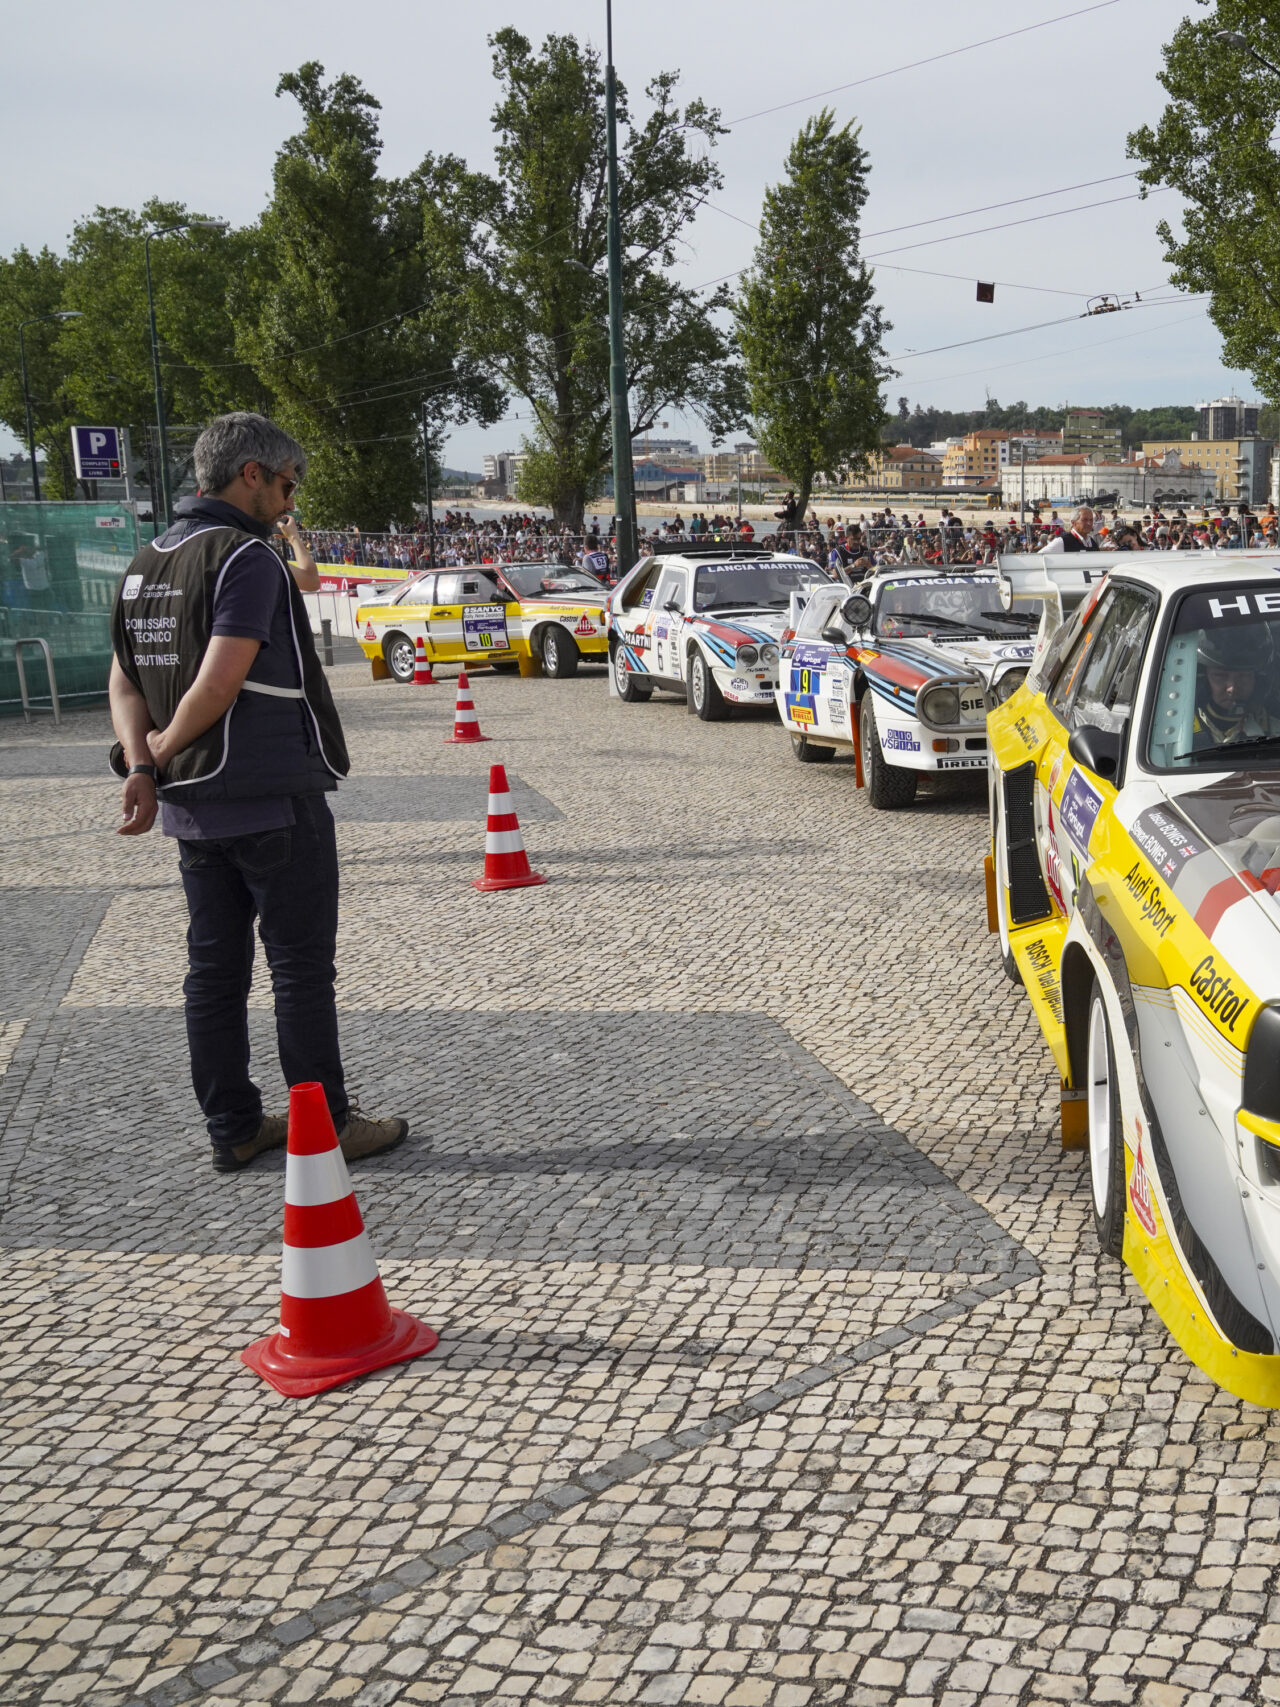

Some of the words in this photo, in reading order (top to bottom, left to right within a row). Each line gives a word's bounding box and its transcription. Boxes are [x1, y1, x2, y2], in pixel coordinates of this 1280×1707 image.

[89, 432, 107, 455] P
[707, 563, 756, 573] LANCIA
[758, 562, 810, 570] MARTINI
[892, 577, 964, 588] LANCIA
[125, 616, 177, 630] COMISSÁRIO
[480, 633, 492, 647] 10
[134, 654, 180, 666] CRUTINEER
[657, 641, 664, 672] 6
[802, 669, 809, 694] 9
[723, 690, 739, 702] WEBER
[961, 697, 996, 711] SIE
[792, 708, 812, 721] PIRELLI
[887, 729, 912, 741] OLIO
[1160, 821, 1188, 847] BOWES
[1145, 832, 1168, 866] BOWES
[1123, 861, 1154, 903] Audi
[1139, 886, 1177, 938] Sport
[1025, 938, 1053, 972] BOSCH
[1190, 955, 1250, 1033] Castrol
[1134, 1163, 1149, 1208] HB
